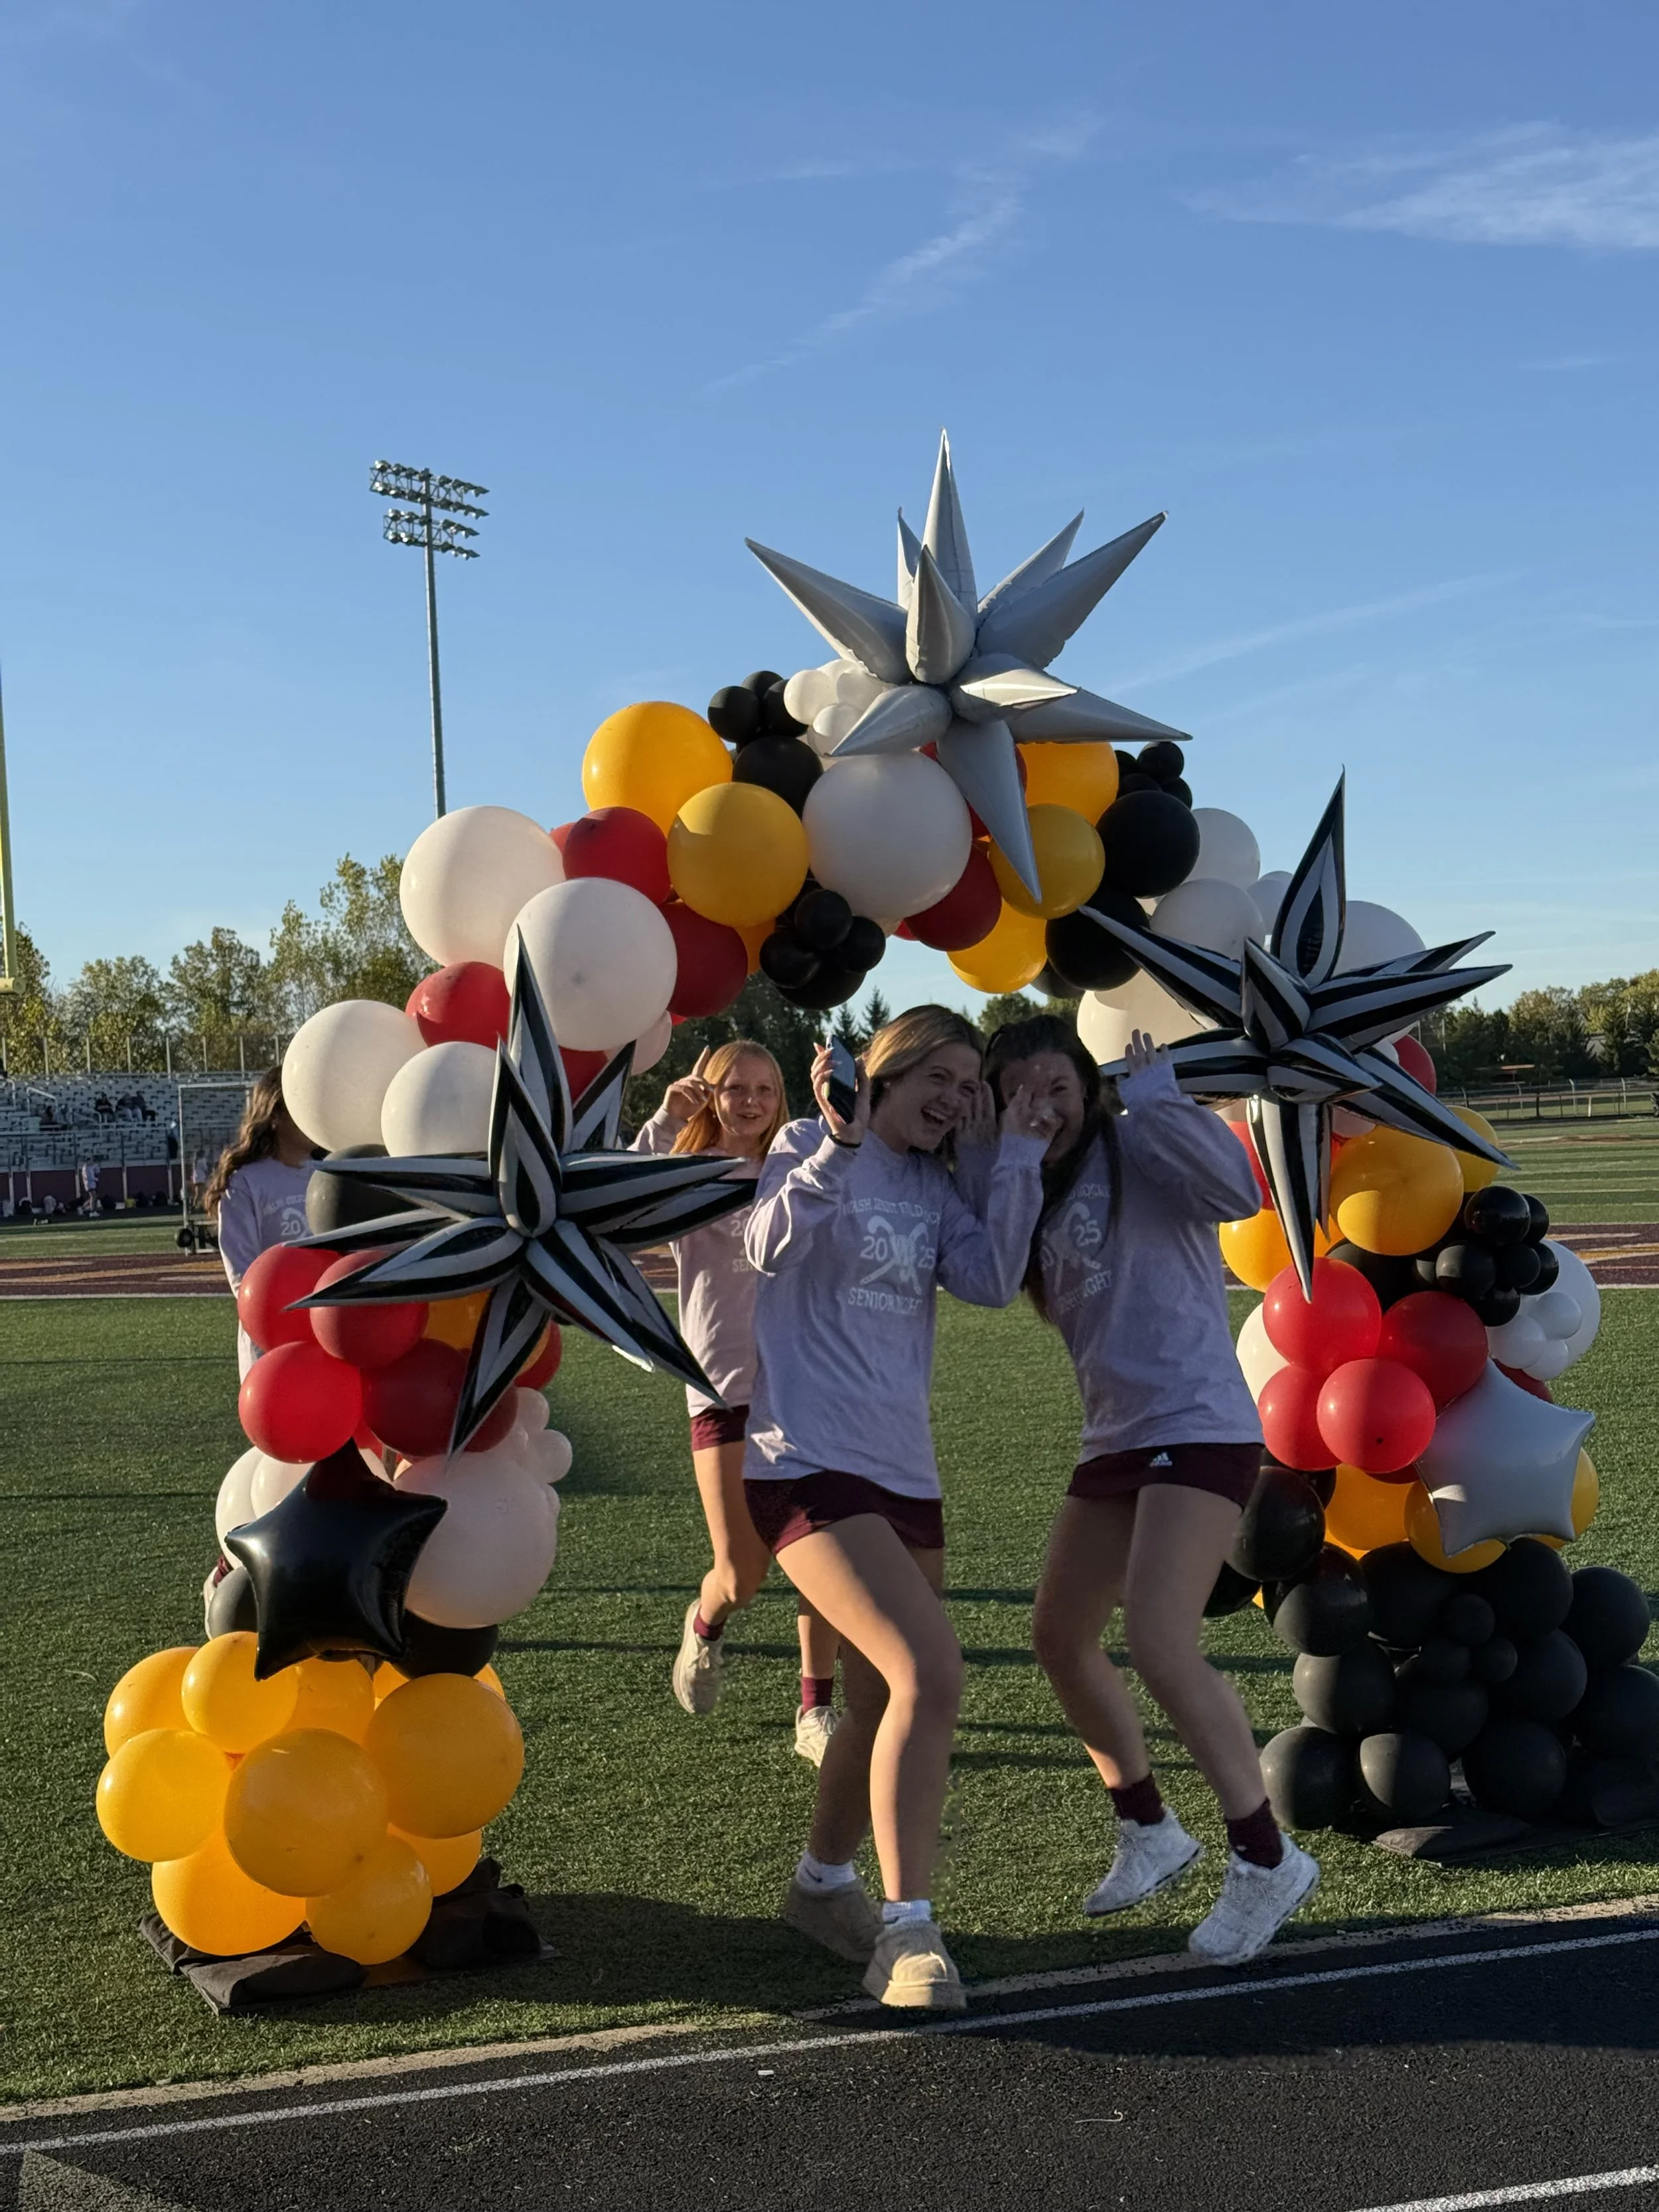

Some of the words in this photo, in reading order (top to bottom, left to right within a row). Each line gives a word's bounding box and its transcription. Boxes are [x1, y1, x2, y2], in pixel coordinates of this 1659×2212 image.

[281, 1220, 301, 1236] 20
[1074, 1219, 1102, 1247] 25
[859, 1236, 887, 1262] 20
[918, 1245, 936, 1270] 25
[847, 1287, 894, 1312] SENIOR
